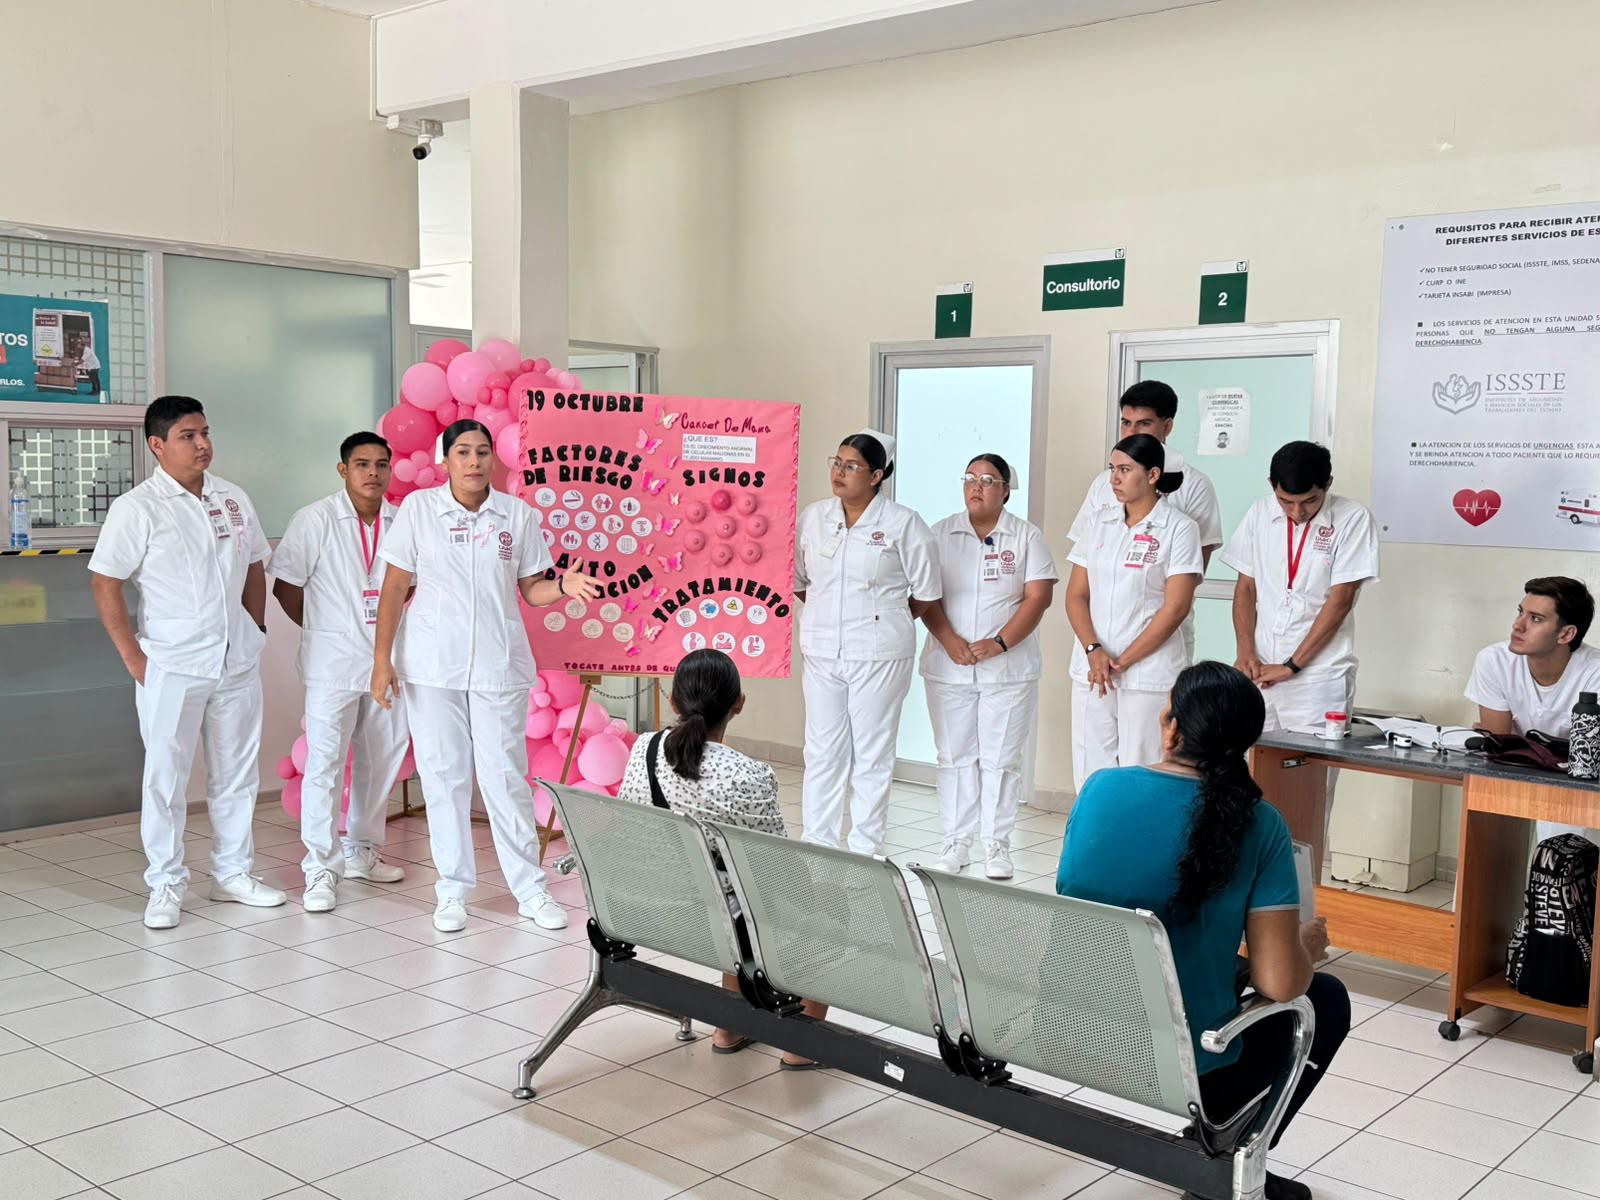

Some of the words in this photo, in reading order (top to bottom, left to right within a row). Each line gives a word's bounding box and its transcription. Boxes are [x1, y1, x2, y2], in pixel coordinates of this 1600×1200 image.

[1435, 223, 1496, 234] REQUISITOS
[1499, 221, 1526, 230] PARA
[1530, 217, 1572, 227] RECIBIR
[1446, 235, 1508, 245] DIFERENTES
[1511, 231, 1567, 241] SERVICIOS
[1459, 263, 1498, 271] SEGURIDAD
[1499, 261, 1522, 269] SOCIAL
[1046, 277, 1121, 294] Consultorio
[1477, 289, 1512, 297] (IMPRESA)
[1218, 292, 1228, 306] 2
[950, 310, 958, 322] 1
[1546, 325, 1576, 333] ALGUNA
[1486, 372, 1566, 391] ISSSTE
[527, 389, 545, 411] 19
[553, 392, 644, 413] OCTUBRE
[1533, 442, 1574, 450] URGENCIAS
[527, 444, 643, 472] FACTORES
[523, 467, 547, 486] DE
[559, 465, 632, 490] RIESGO
[682, 467, 765, 487] SIGNOS
[652, 577, 790, 623] TRATAMIENTO
[611, 664, 641, 672] ANTES
[1535, 884, 1549, 926] STEVE
